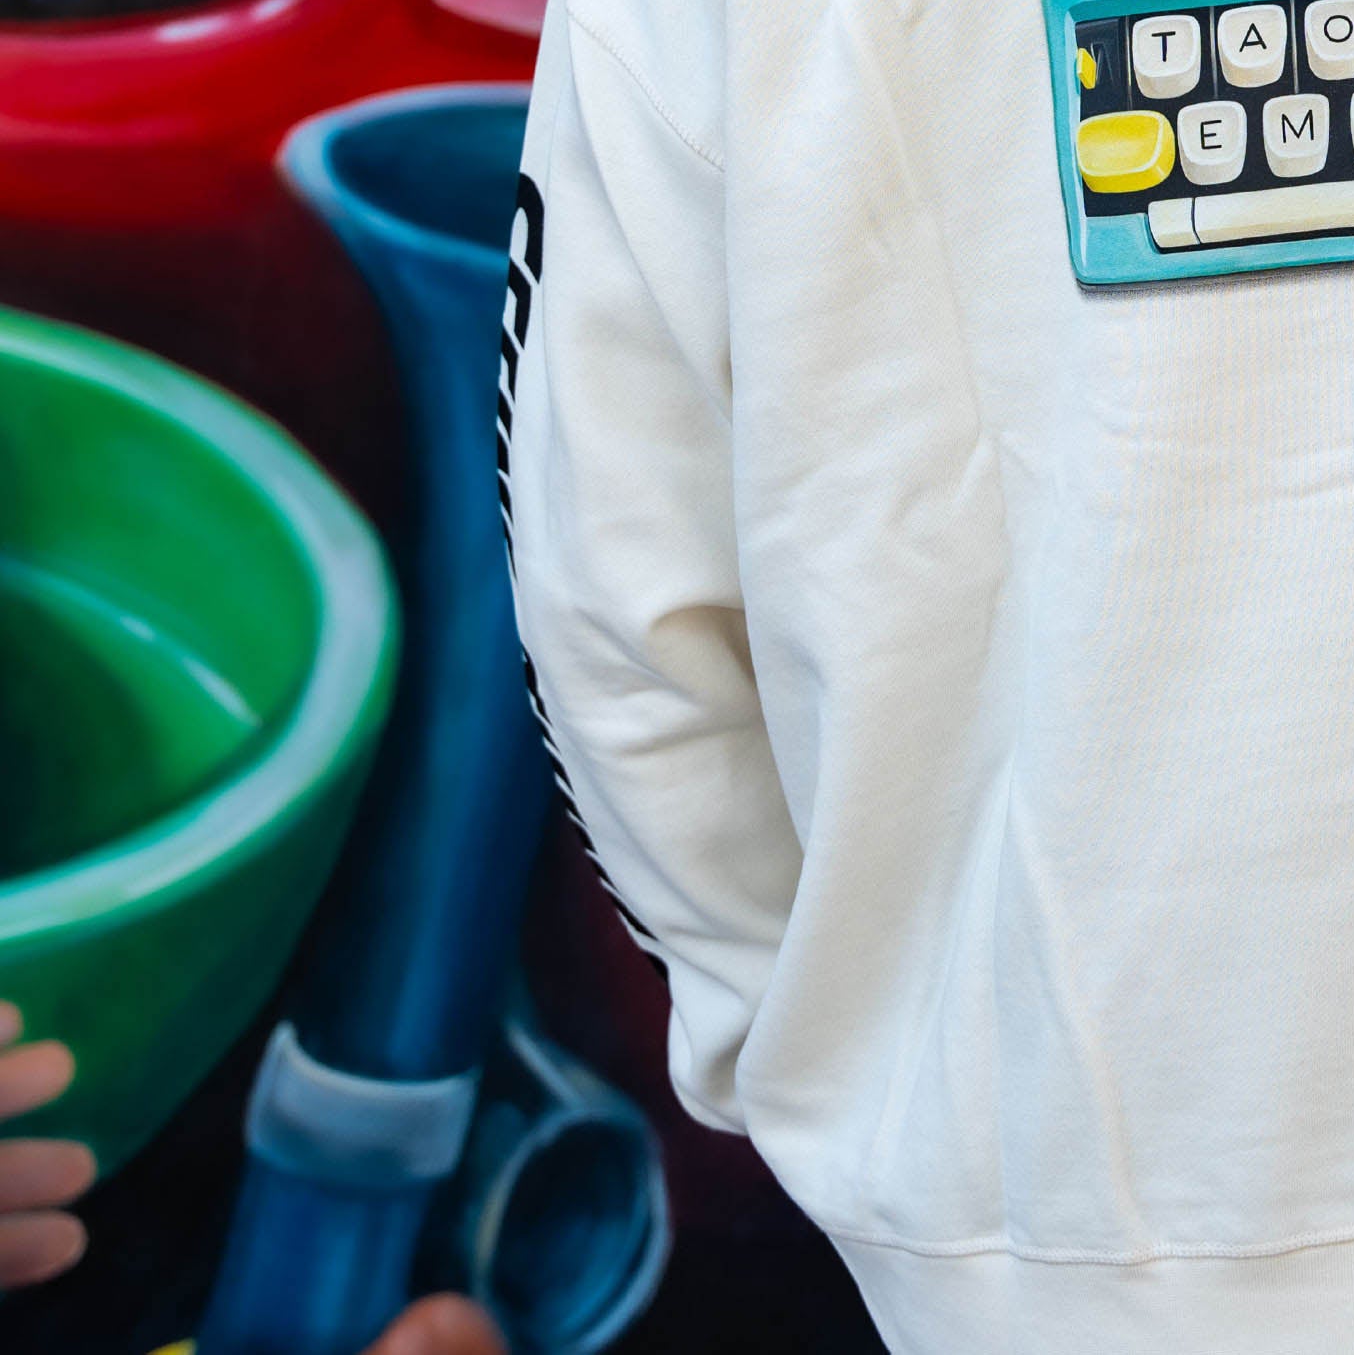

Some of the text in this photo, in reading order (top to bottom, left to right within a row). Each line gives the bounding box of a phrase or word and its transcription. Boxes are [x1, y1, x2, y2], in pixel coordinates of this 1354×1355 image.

[1151, 30, 1177, 63] T
[1238, 22, 1267, 53] A
[1322, 13, 1354, 44] O
[1199, 118, 1223, 151] E
[1281, 109, 1315, 144] M
